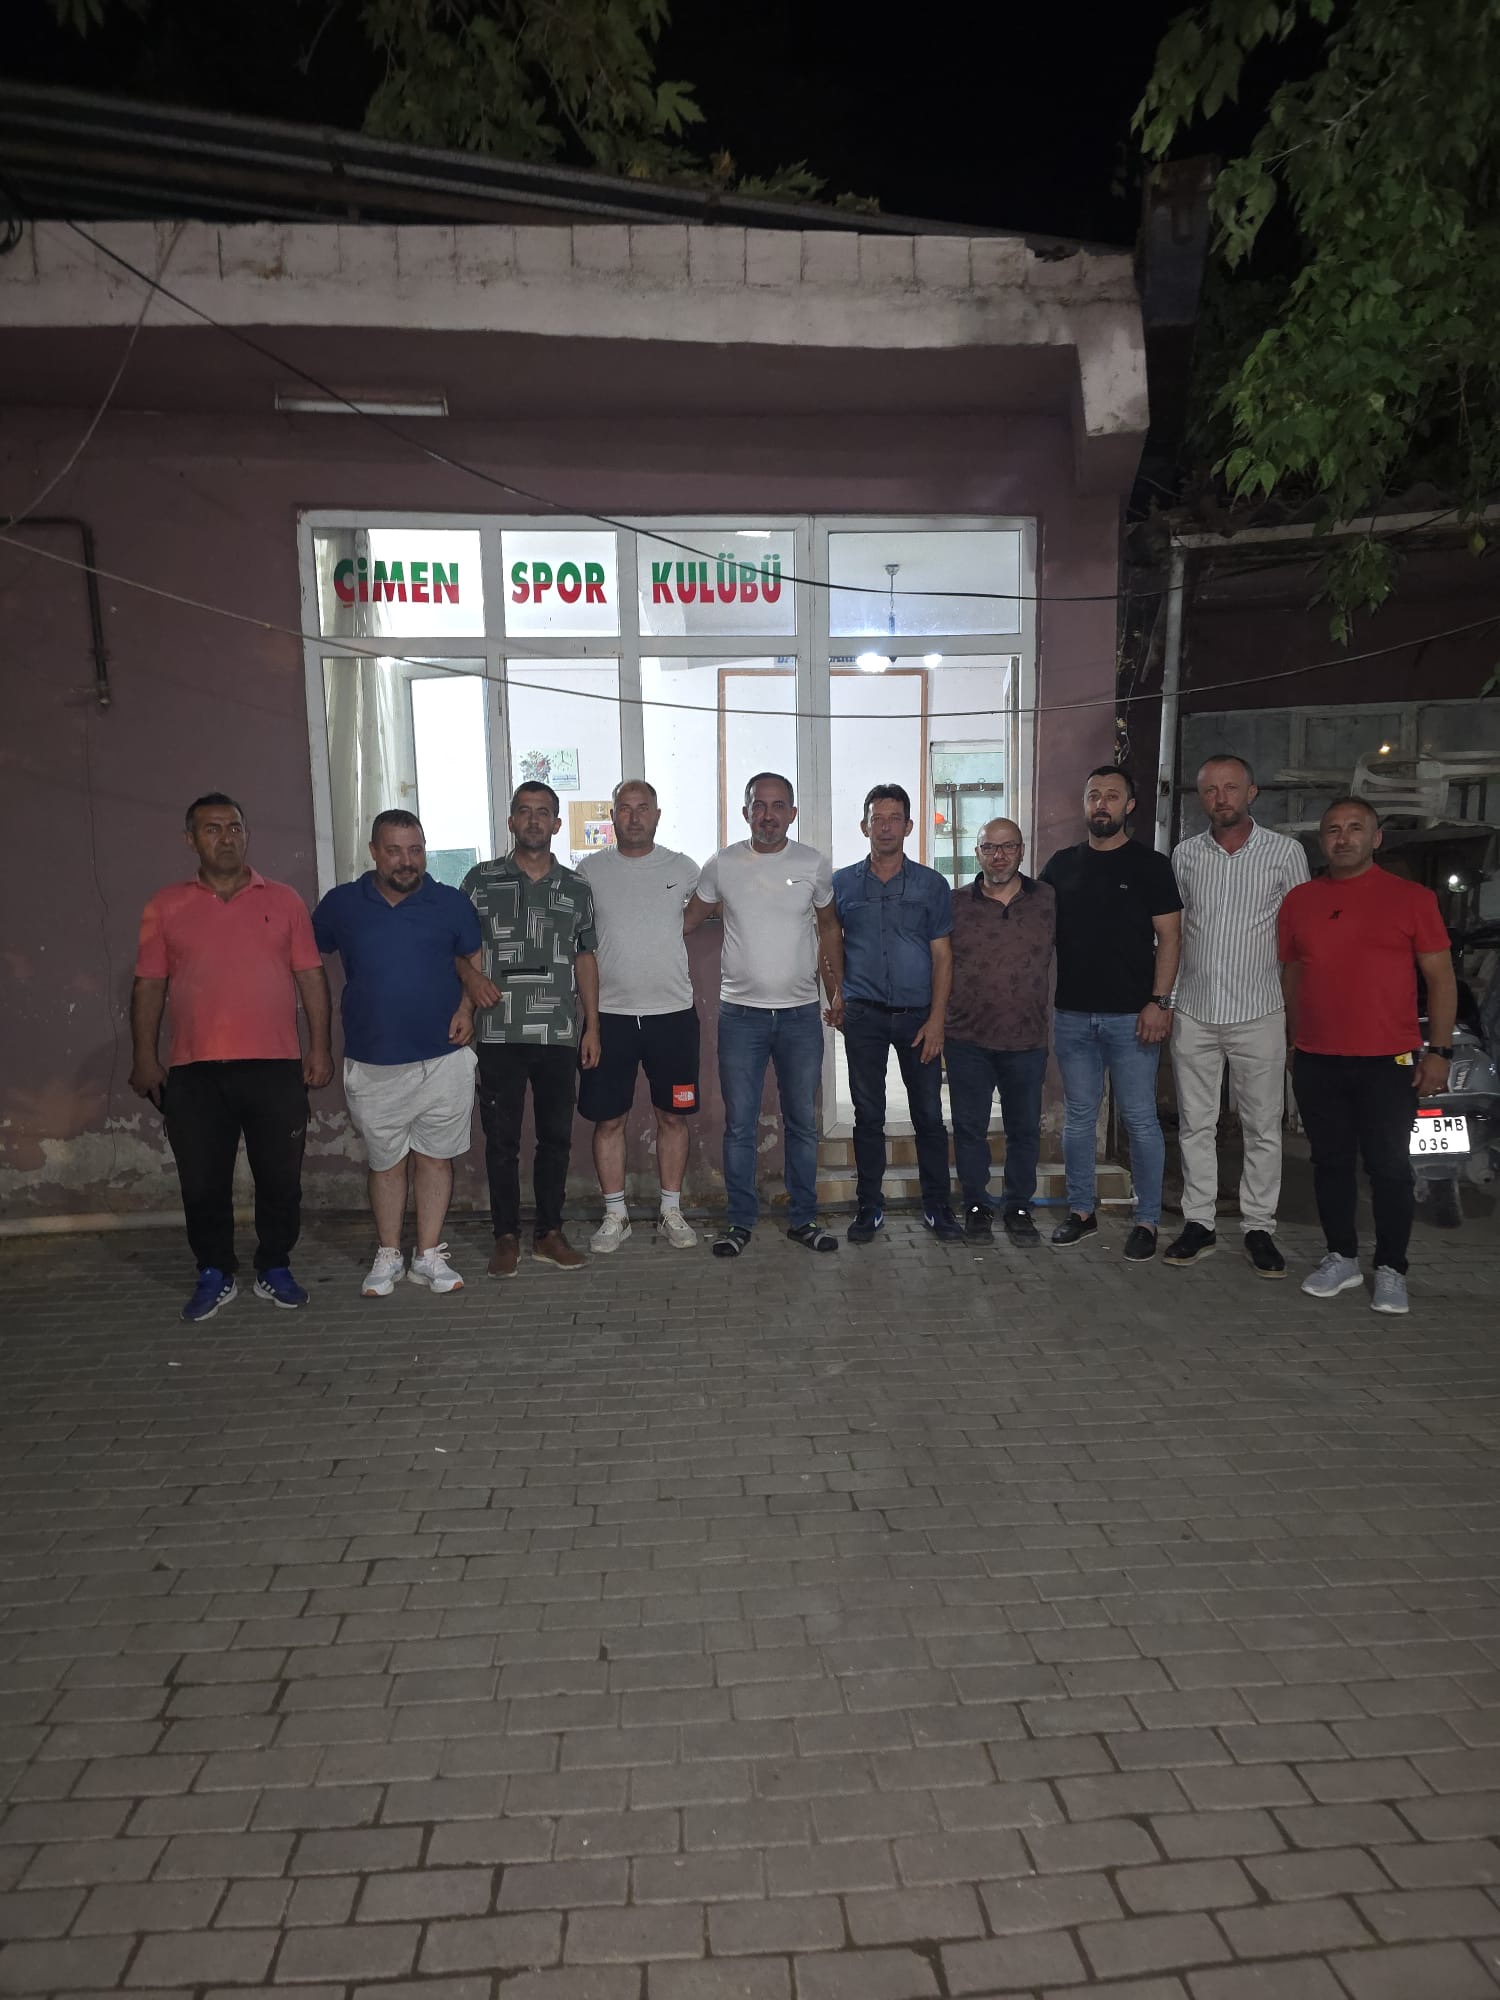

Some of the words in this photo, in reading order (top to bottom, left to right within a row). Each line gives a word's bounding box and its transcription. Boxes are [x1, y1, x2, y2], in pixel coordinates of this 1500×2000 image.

[511, 561, 607, 605] SPOR
[651, 552, 782, 605] KULÜBÜ
[1433, 1118, 1464, 1133] BMB
[1418, 1137, 1449, 1152] 036
